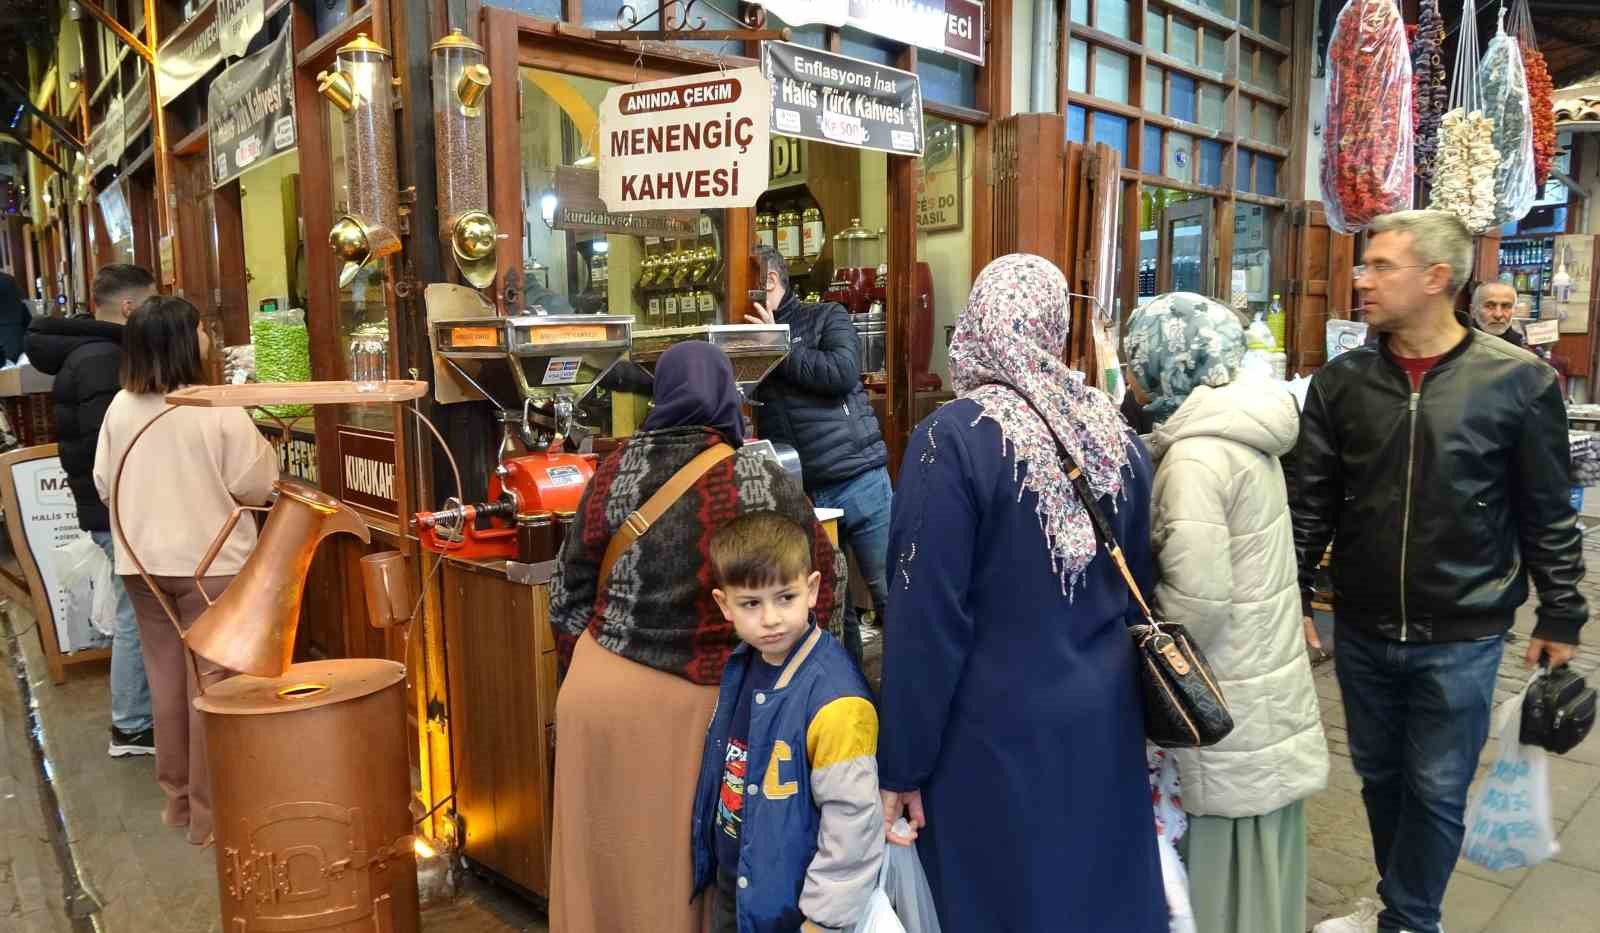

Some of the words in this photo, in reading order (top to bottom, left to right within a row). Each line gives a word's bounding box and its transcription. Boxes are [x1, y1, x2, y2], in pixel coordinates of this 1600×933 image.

[794, 55, 871, 88] Enflasyona
[874, 71, 897, 94] İnat
[627, 91, 680, 111] ANINDA
[782, 77, 818, 109] Halis
[822, 86, 852, 115] Türk
[855, 93, 905, 126] Kahvesi
[610, 111, 754, 154] MENENGİÇ
[621, 160, 739, 201] KAHVESİ
[938, 193, 955, 209] DO
[762, 739, 799, 800] C
